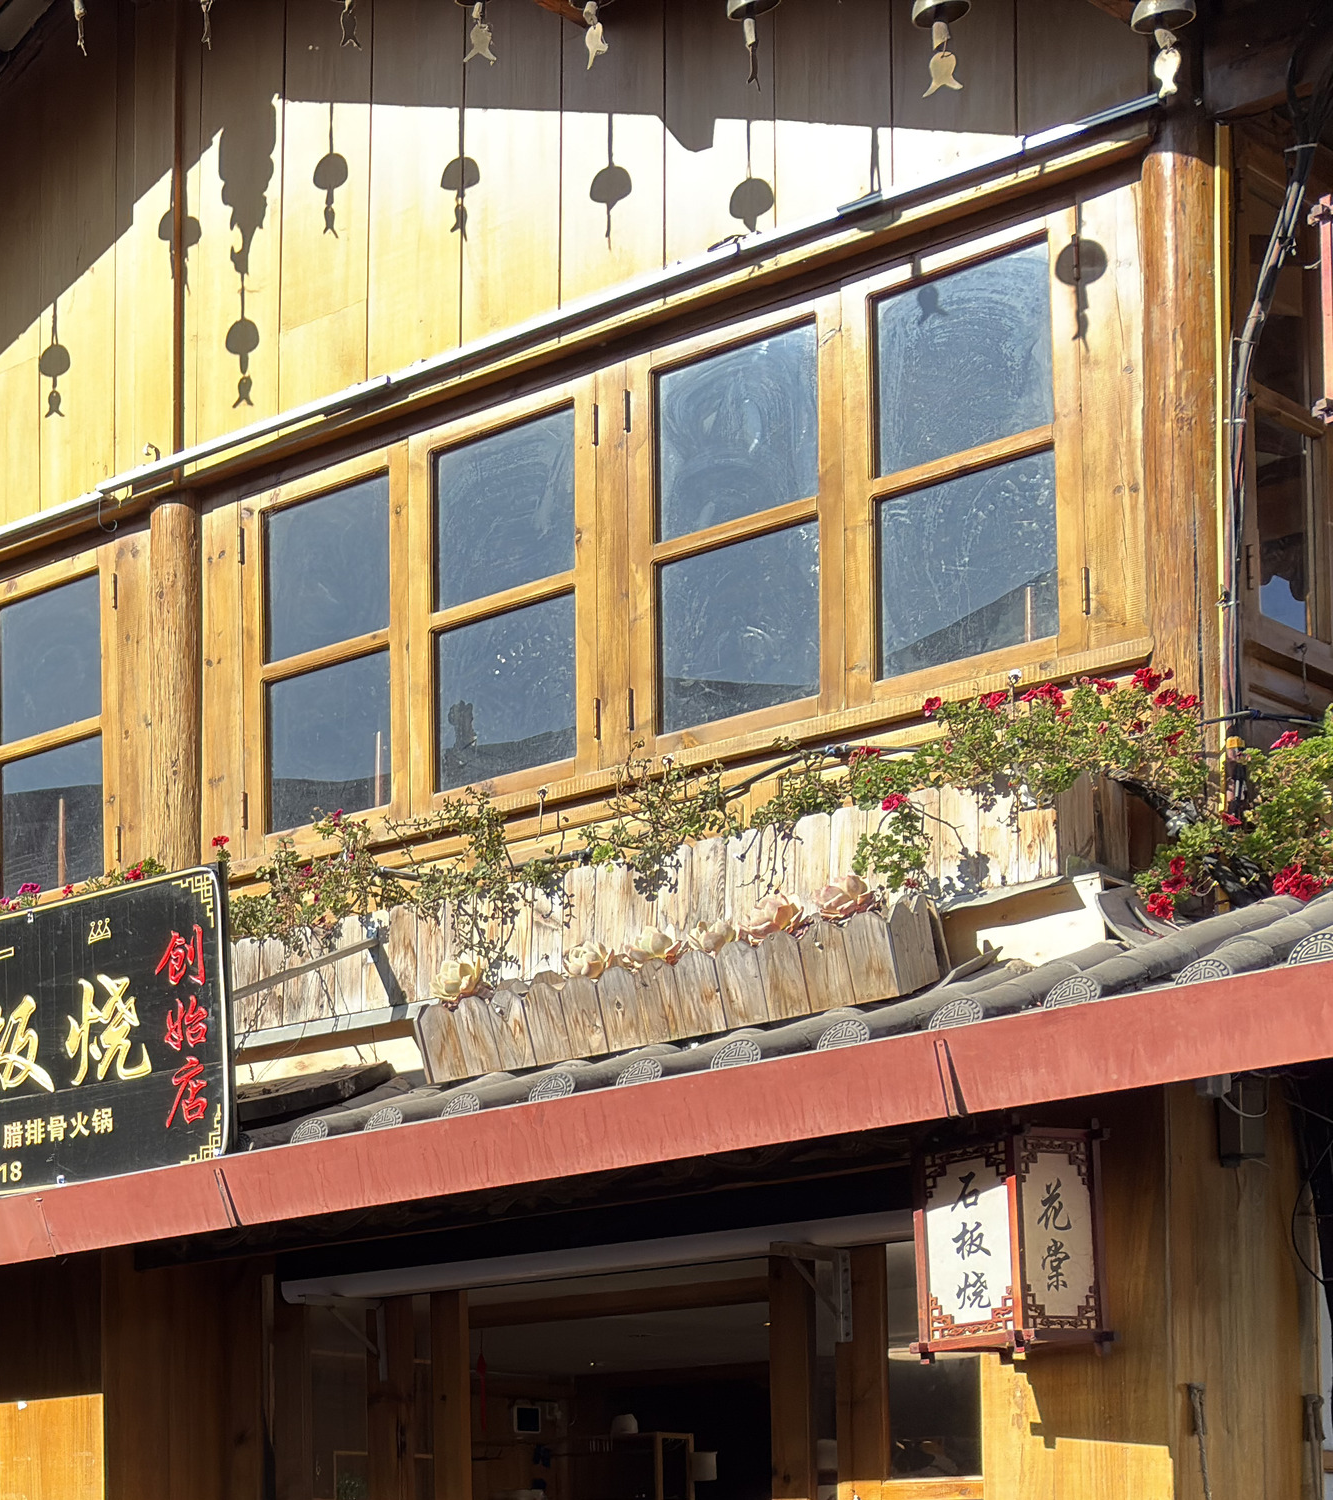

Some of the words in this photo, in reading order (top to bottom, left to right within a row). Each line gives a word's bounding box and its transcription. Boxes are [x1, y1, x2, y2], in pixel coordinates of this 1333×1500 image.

[155, 924, 208, 1128] 创始店
[951, 1171, 992, 1310] 石板烧
[1037, 1178, 1072, 1292] 花棠
